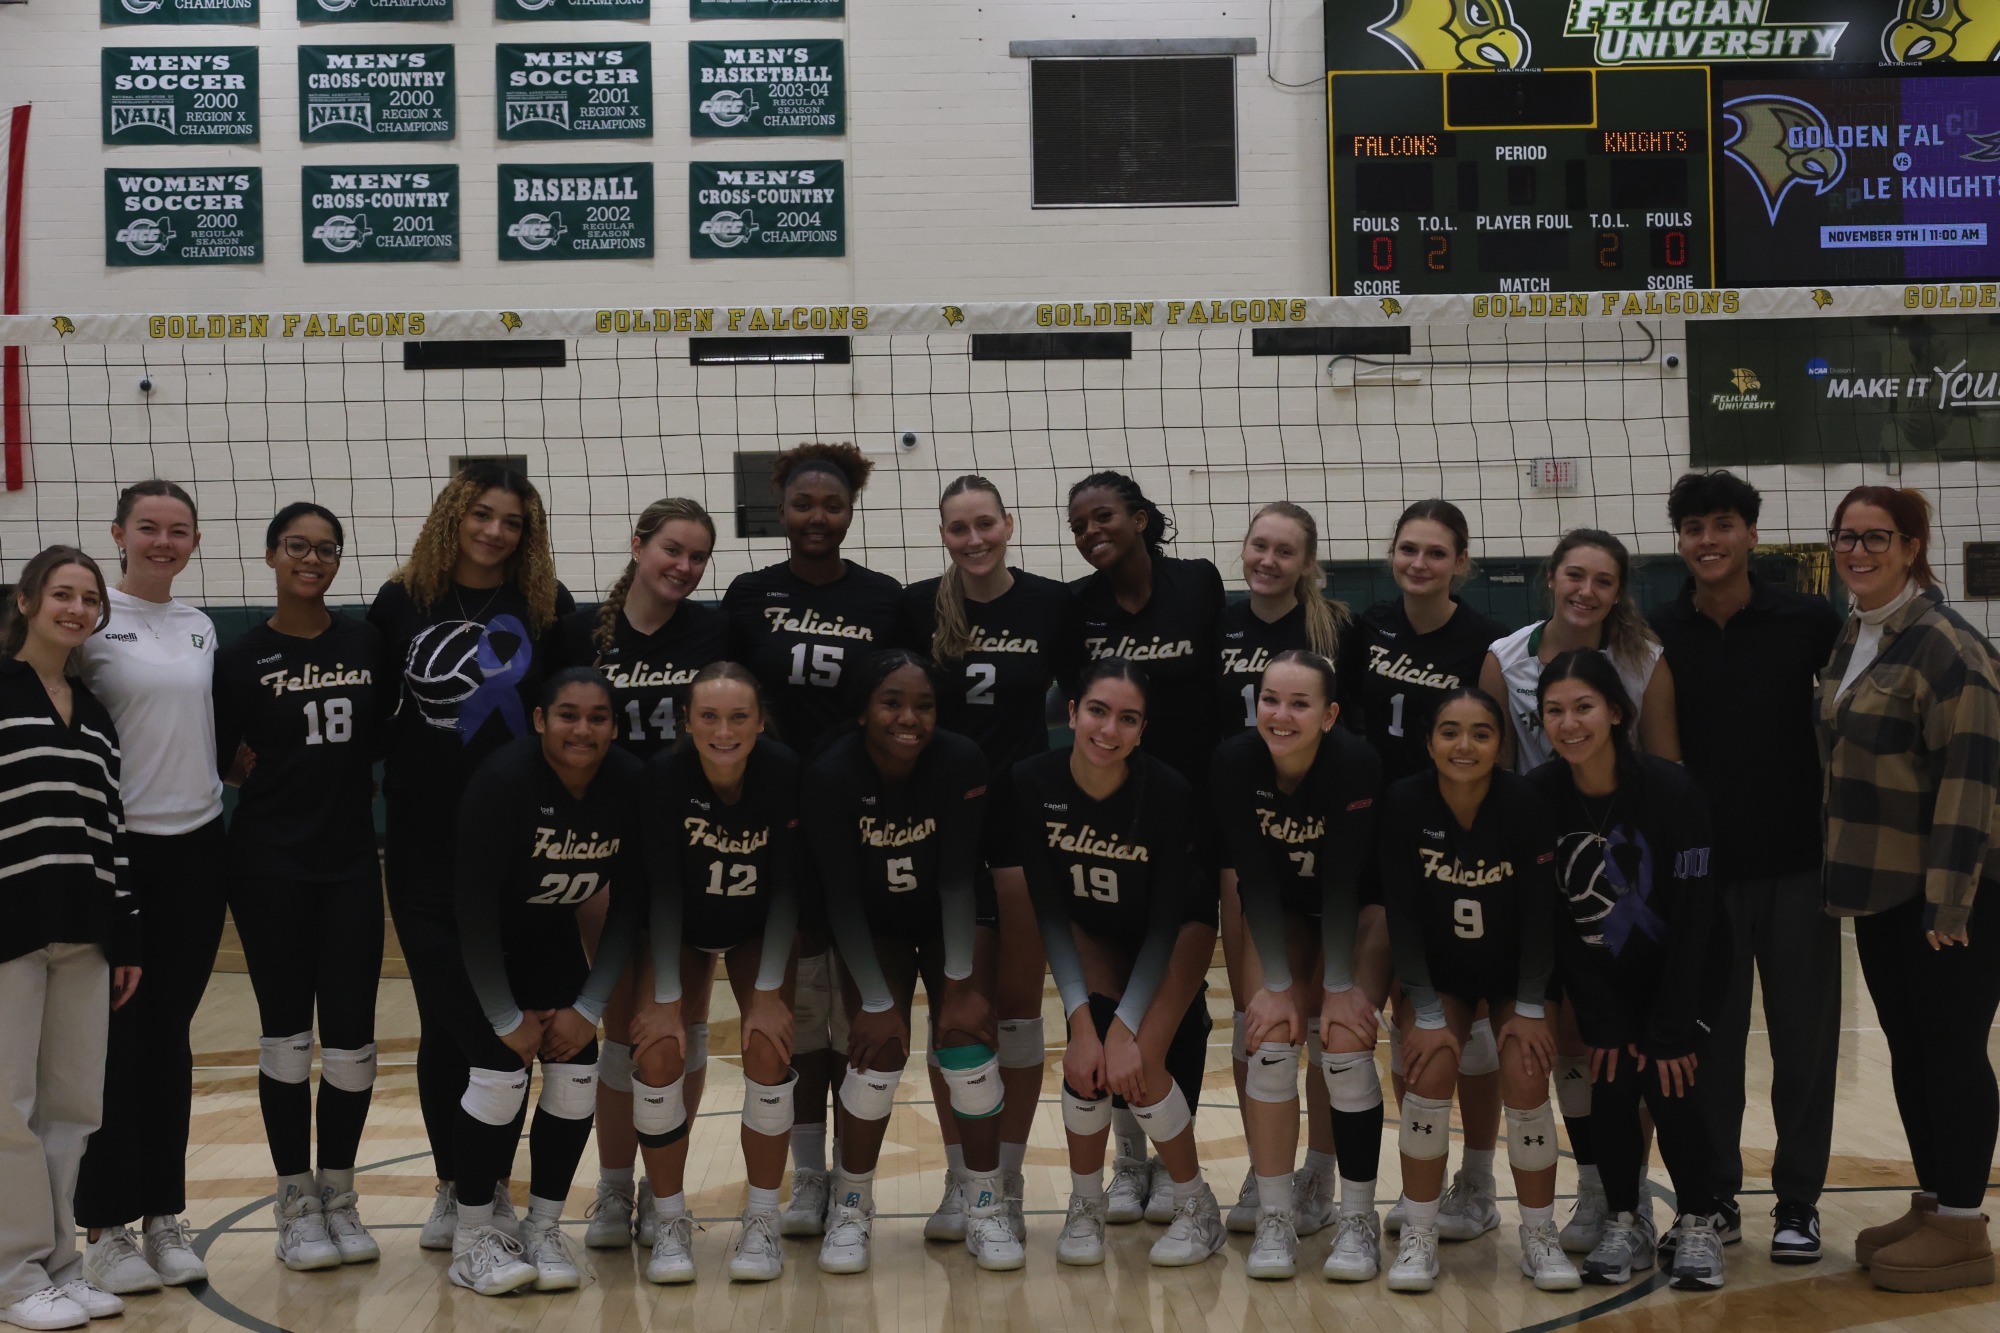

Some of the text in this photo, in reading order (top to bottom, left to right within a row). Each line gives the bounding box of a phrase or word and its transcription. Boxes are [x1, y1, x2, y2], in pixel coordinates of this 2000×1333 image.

[1571, 0, 1764, 31] FELICIAN
[1597, 27, 1831, 61] UNIVERSITY
[130, 55, 230, 71] MEN'S
[326, 53, 426, 69] MEN'S
[524, 50, 624, 67] MEN'S
[724, 47, 809, 65] MEN'S
[115, 74, 246, 90] SOCCER
[308, 72, 445, 89] CROSS-COUNTRY
[509, 69, 639, 87] SOCCER
[700, 66, 832, 84] BASKETBALL
[389, 90, 434, 106] 2000
[588, 88, 630, 104] 2001
[768, 83, 829, 98] 2003-04
[193, 93, 238, 109] 2000
[186, 112, 246, 122] REGION X
[310, 105, 370, 129] NAIA
[382, 108, 442, 119] REGION X
[508, 102, 568, 127] NAIA
[580, 106, 640, 117] REGION X
[777, 106, 820, 114] SEASON
[113, 107, 174, 131] NAIA
[376, 121, 449, 133] CHAMPIONS
[573, 118, 646, 130] CHAMPIONS
[763, 115, 836, 127] CHAMPIONS
[180, 124, 253, 135] CHAMPIONS
[1788, 125, 1888, 149] GOLDEN
[1354, 135, 1438, 157] FALCONS
[1604, 130, 1688, 152] KNIGHTS
[1495, 145, 1547, 161] PERIOD
[1896, 157, 1909, 167] VS
[118, 175, 250, 192] WOMEN'S
[330, 173, 430, 190] MEN'S
[717, 169, 816, 185] MEN'S
[513, 176, 639, 202] BASEBALL
[698, 188, 835, 205] CROSS-COUNTRY
[124, 195, 244, 211] SOCCER
[312, 193, 450, 209] CROSS-COUNTRY
[197, 214, 238, 228] 2000
[586, 207, 631, 222] 2002
[777, 212, 821, 228] 2004
[1476, 214, 1573, 230] PLAYER FOUL
[1590, 214, 1629, 229] T.O.L.
[1646, 212, 1693, 227] FOULS
[393, 216, 434, 232] 2001
[582, 223, 635, 231] REGULAR
[1353, 217, 1400, 232] FOULS
[1418, 216, 1458, 231] T.O.L.
[191, 230, 244, 238] REGULAR
[375, 235, 452, 248] CHAMPIONS
[587, 230, 630, 238] SEASON
[761, 230, 837, 243] CHAMPIONS
[1828, 230, 1892, 243] NOVEMBER
[1896, 229, 1919, 242] 9TH
[1929, 229, 1958, 241] 11:00
[1961, 228, 1979, 240] AM
[181, 246, 254, 258] CHAMPIONS
[573, 238, 645, 250] CHAMPIONS
[1428, 235, 1448, 270] 2
[1599, 232, 1619, 267] 2
[1665, 231, 1685, 266] 0
[1372, 236, 1393, 271] 0
[1354, 280, 1400, 296] SCORE
[1500, 277, 1550, 293] MATCH
[1647, 275, 1694, 290] SCORE
[1473, 291, 1740, 318] GOLDEN FALCONS
[1904, 285, 2000, 310] GOLDE
[595, 306, 869, 333] GOLDEN FALCONS
[1036, 299, 1307, 327] GOLDEN FALCONS
[149, 313, 425, 339] GOLDEN FALCONS
[1808, 367, 1828, 375] NCAA
[1827, 378, 1900, 399] MAKE
[1906, 377, 1932, 398] IT
[1933, 359, 2000, 410] YOU
[1712, 394, 1758, 404] FELICIAN
[1718, 401, 1775, 411] UNIVERSITY
[764, 606, 874, 642] Felician
[105, 632, 138, 641] capelli
[1084, 635, 1194, 662] Felician
[788, 642, 845, 688] 15
[1220, 647, 1274, 676] Felic
[1368, 644, 1460, 690] Felician
[260, 663, 373, 698] Felician
[965, 663, 996, 705] 2
[1240, 683, 1257, 727] 1
[303, 697, 353, 745] 18
[624, 696, 676, 741] 14
[1387, 693, 1404, 738] 1
[1044, 801, 1068, 812] capelli
[531, 826, 621, 860] Felician
[1045, 821, 1150, 863] Felician
[886, 856, 918, 893] 5
[1418, 847, 1514, 887] Felician
[705, 860, 758, 897] 12
[1070, 863, 1119, 904] 19
[526, 872, 600, 905] 20
[1453, 898, 1485, 939] 9
